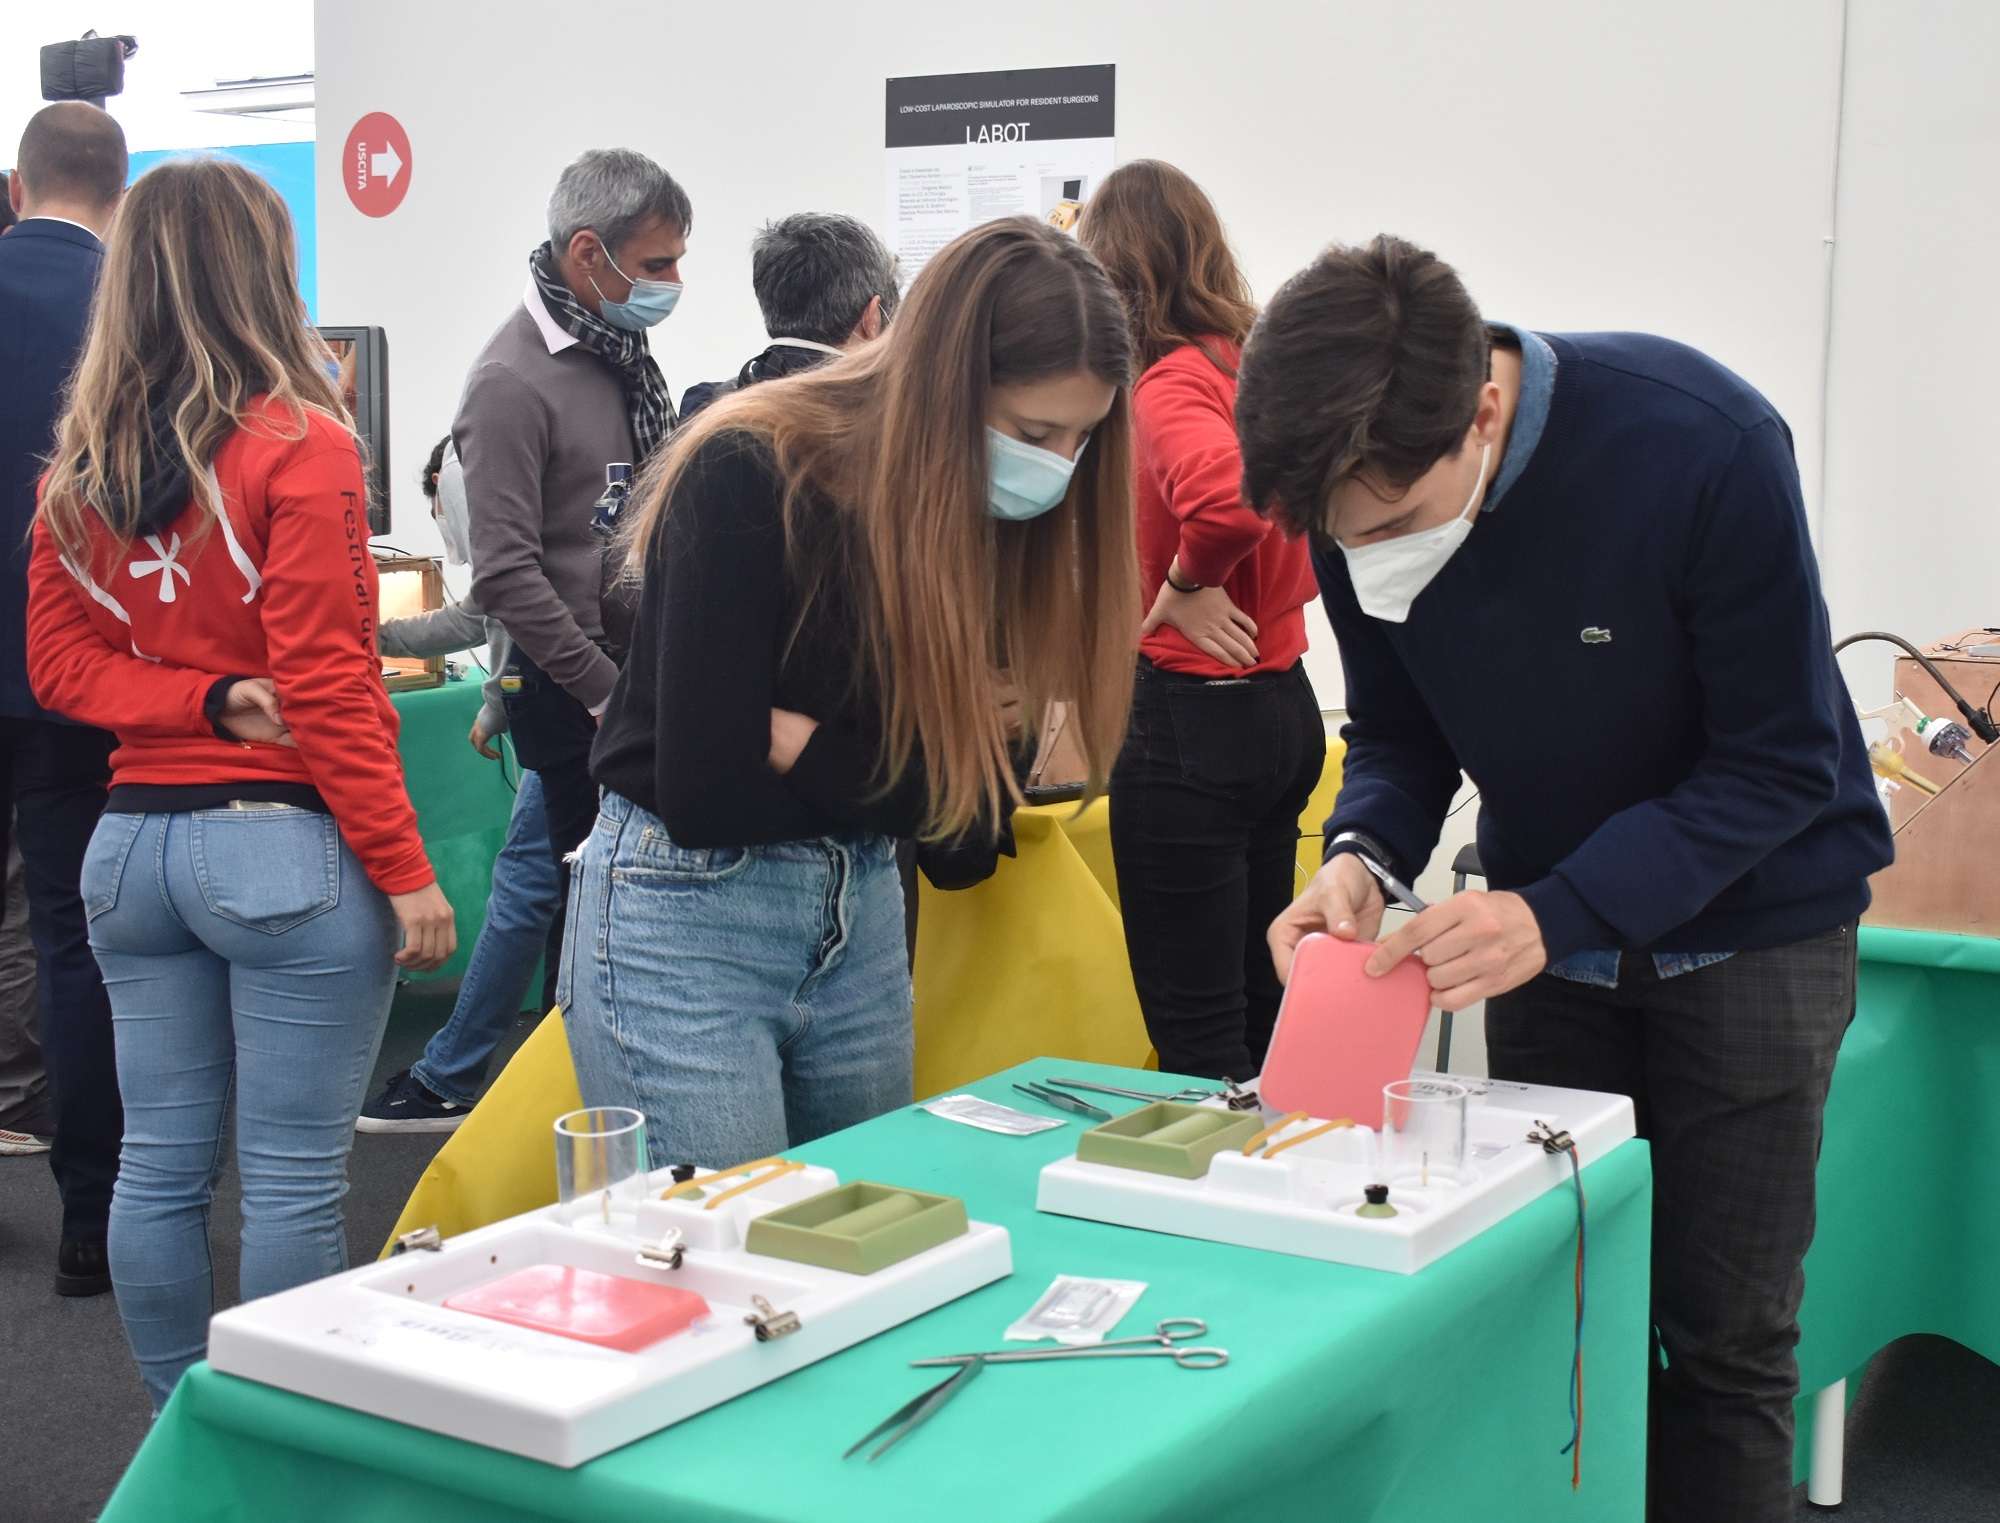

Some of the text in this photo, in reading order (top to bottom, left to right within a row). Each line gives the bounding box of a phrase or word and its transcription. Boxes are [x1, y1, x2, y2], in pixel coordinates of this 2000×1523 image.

[900, 94, 1099, 114] LOW-COST LAPAROSCOPIC SIMULATOR FOR RESIDENT SURGEONS
[966, 122, 1031, 144] LABOT
[357, 142, 367, 190] USCITA
